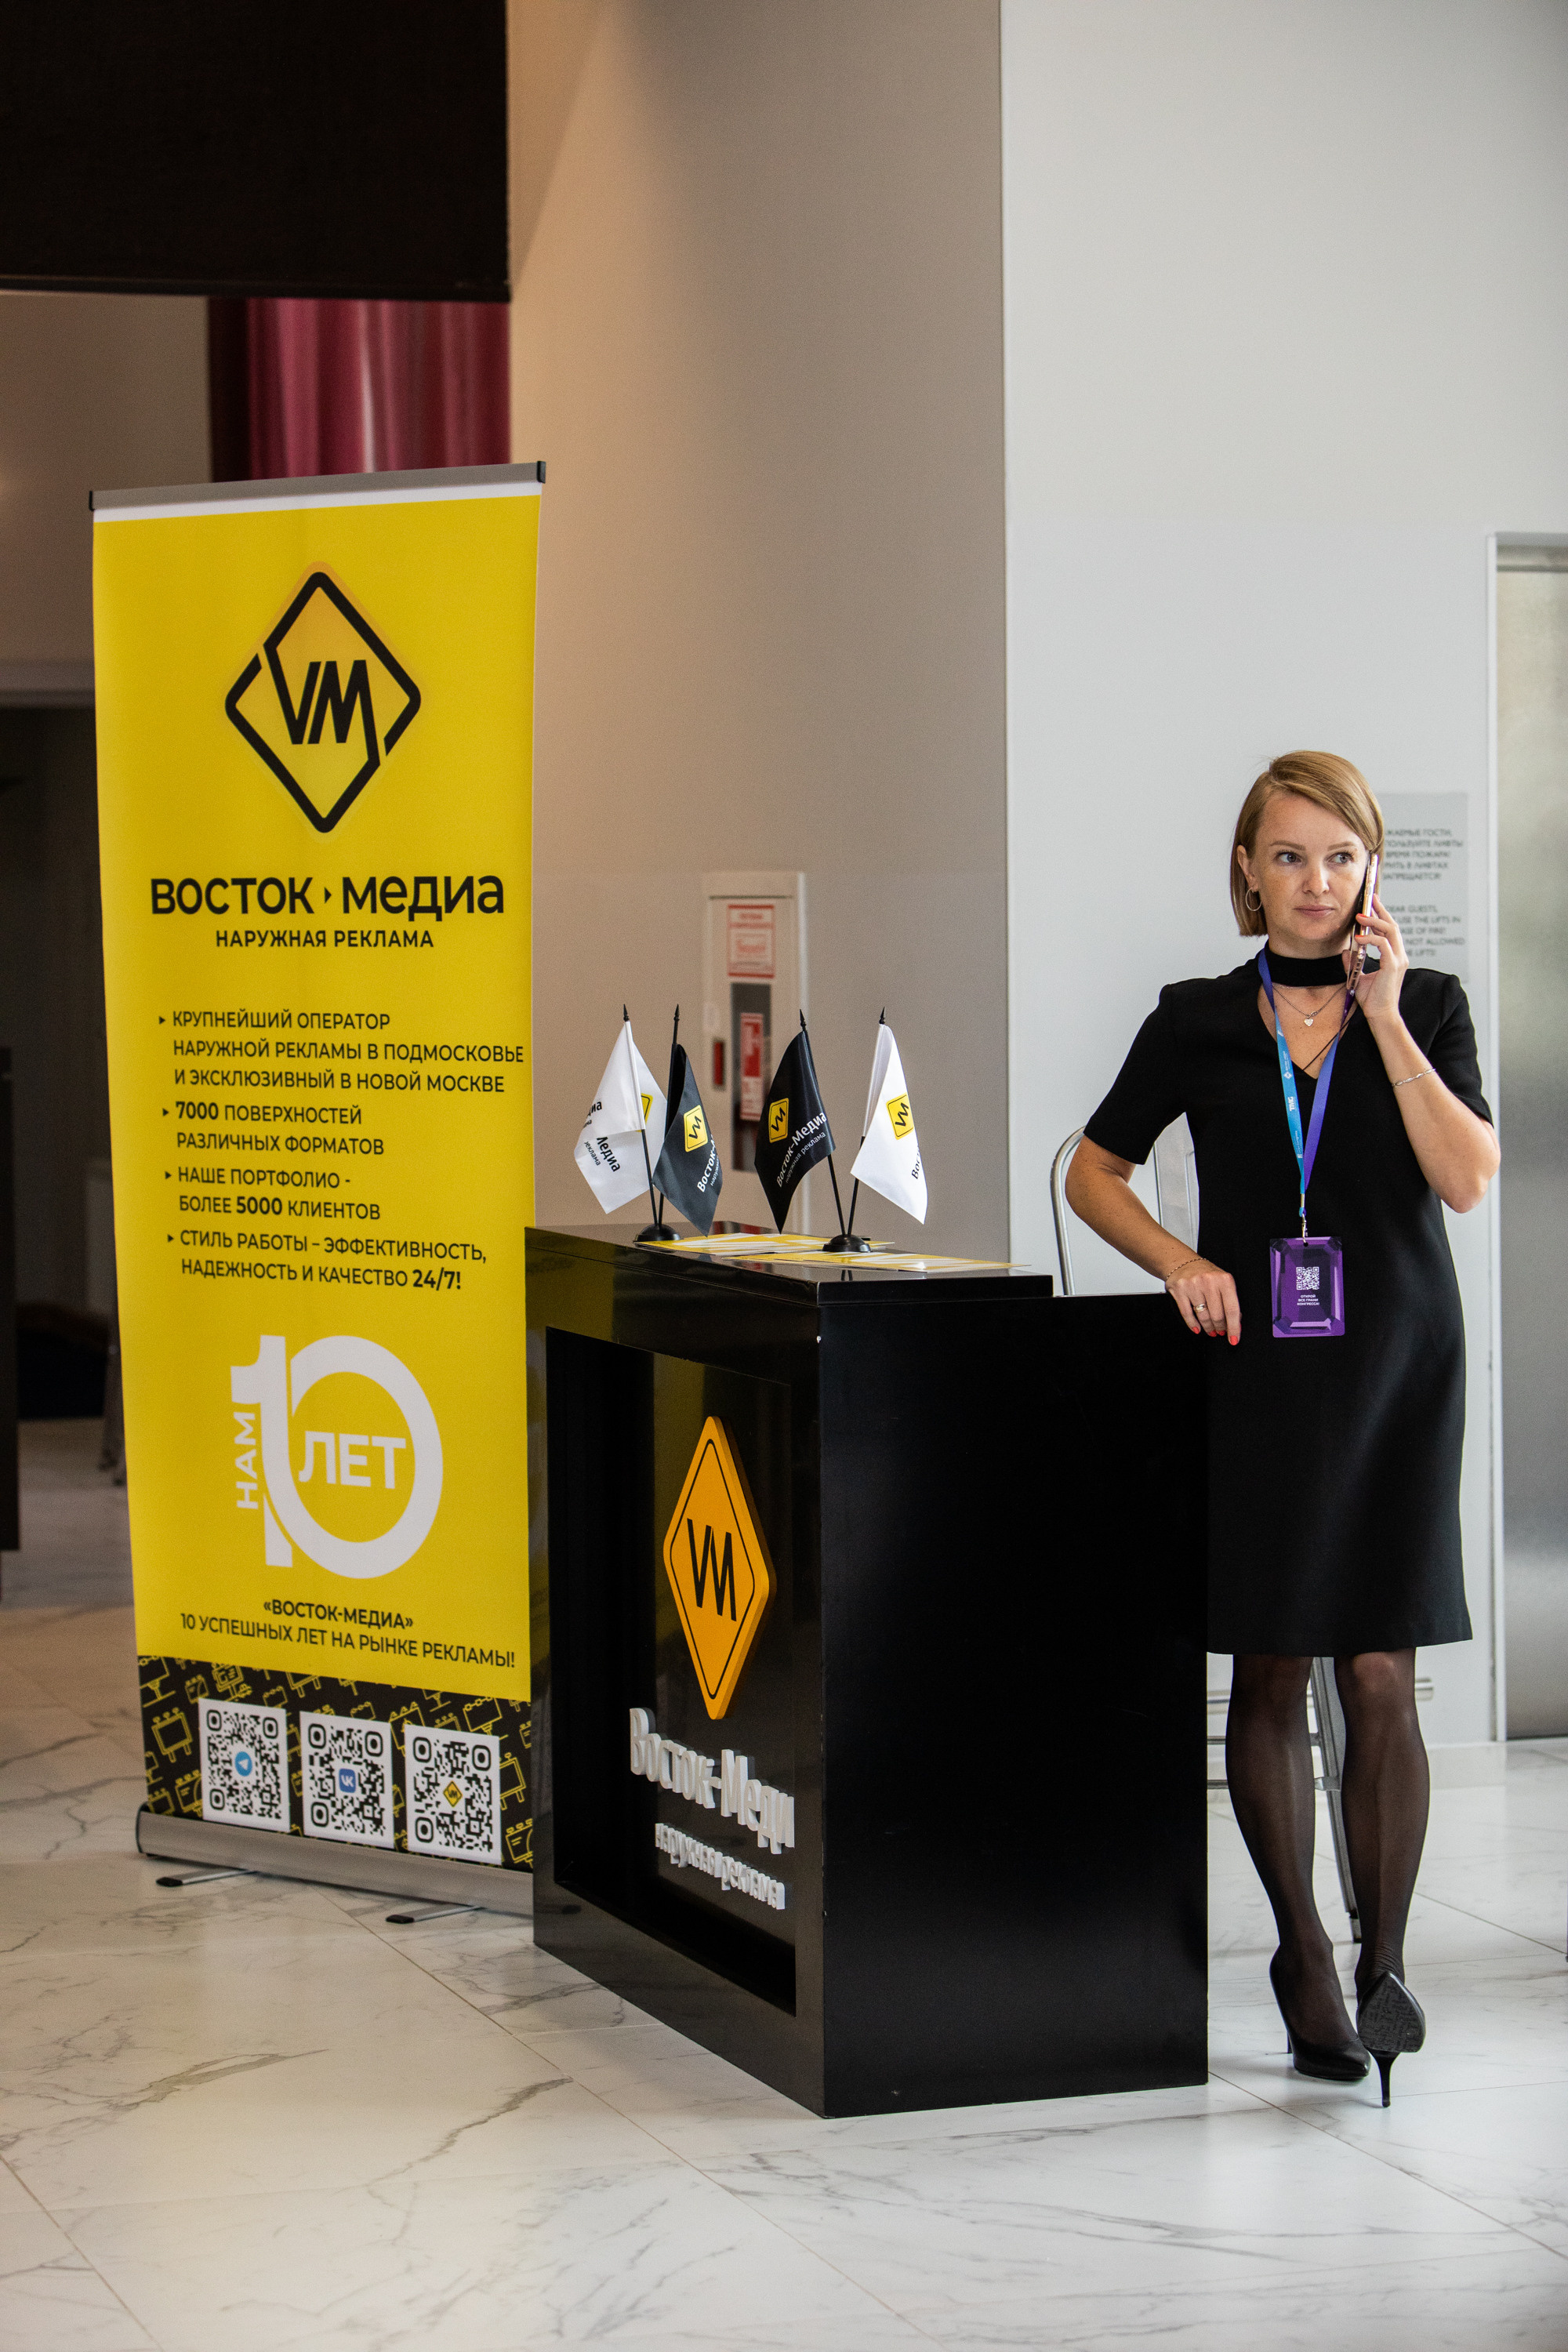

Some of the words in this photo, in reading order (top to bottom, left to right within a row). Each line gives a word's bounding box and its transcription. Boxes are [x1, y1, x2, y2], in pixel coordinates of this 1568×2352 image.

[267, 659, 379, 746] VM
[216, 930, 326, 948] НАРУЖНАЯ
[334, 930, 434, 948] РЕКЛАМА
[172, 1008, 292, 1029] КРУПНЕЙШИЙ
[297, 1012, 390, 1030] ОПЕРАТОР
[173, 1038, 270, 1058] НАРУЖНОЙ
[275, 1041, 361, 1059] РЕКЛАМЫ
[367, 1043, 379, 1060] В
[384, 1044, 524, 1064] ПОДМОСКОВЬЕ
[174, 1069, 185, 1084] И
[190, 1069, 335, 1089] ЭКСКЛЮЗИВНЫЙ
[340, 1073, 352, 1089] В
[357, 1070, 421, 1091] НОВОЙ
[426, 1075, 505, 1093] МОСКВЕ
[175, 1101, 219, 1120] 7000
[224, 1104, 361, 1125] ПОВЕРХНОСТЕЙ
[176, 1132, 281, 1152] РАЗЛИЧНЫХ
[285, 1135, 384, 1156] ФОРМАТОВ
[776, 1112, 827, 1188] Восток-Медиа
[800, 1131, 826, 1155] реклама
[178, 1167, 226, 1185] НАШЕ
[230, 1168, 340, 1189] ПОРТФОЛИО
[179, 1195, 232, 1214] БОЛЕЕ
[236, 1196, 283, 1216] 5000
[288, 1200, 380, 1220] КЛИЕНТОВ
[180, 1229, 233, 1248] СТИЛЬ
[237, 1232, 307, 1252] РАБОТЫ
[324, 1236, 486, 1264] ЭФФЕКТИВНОСТЬ,
[181, 1258, 298, 1280] НАДЕЖНОСТЬ
[302, 1265, 313, 1282] И
[318, 1266, 408, 1287] КАЧЕСТВО
[412, 1267, 461, 1291] 24/7!
[230, 1334, 443, 1579] 10
[232, 1411, 259, 1510] НАМ
[298, 1431, 406, 1490] ЛЕТ
[687, 1518, 738, 1622] VM
[263, 1599, 413, 1630] «ВОСТОК-МЕДИА»
[180, 1613, 196, 1630] 10
[198, 1615, 293, 1642] УСПЕШНЫХ
[296, 1627, 328, 1646] ЛЕТ
[332, 1631, 355, 1650] НА
[359, 1634, 418, 1657] РЫНКЕ
[423, 1642, 515, 1668] РЕКЛАМЫ!
[655, 1823, 723, 1868] наружная
[721, 1856, 786, 1910] реклама
